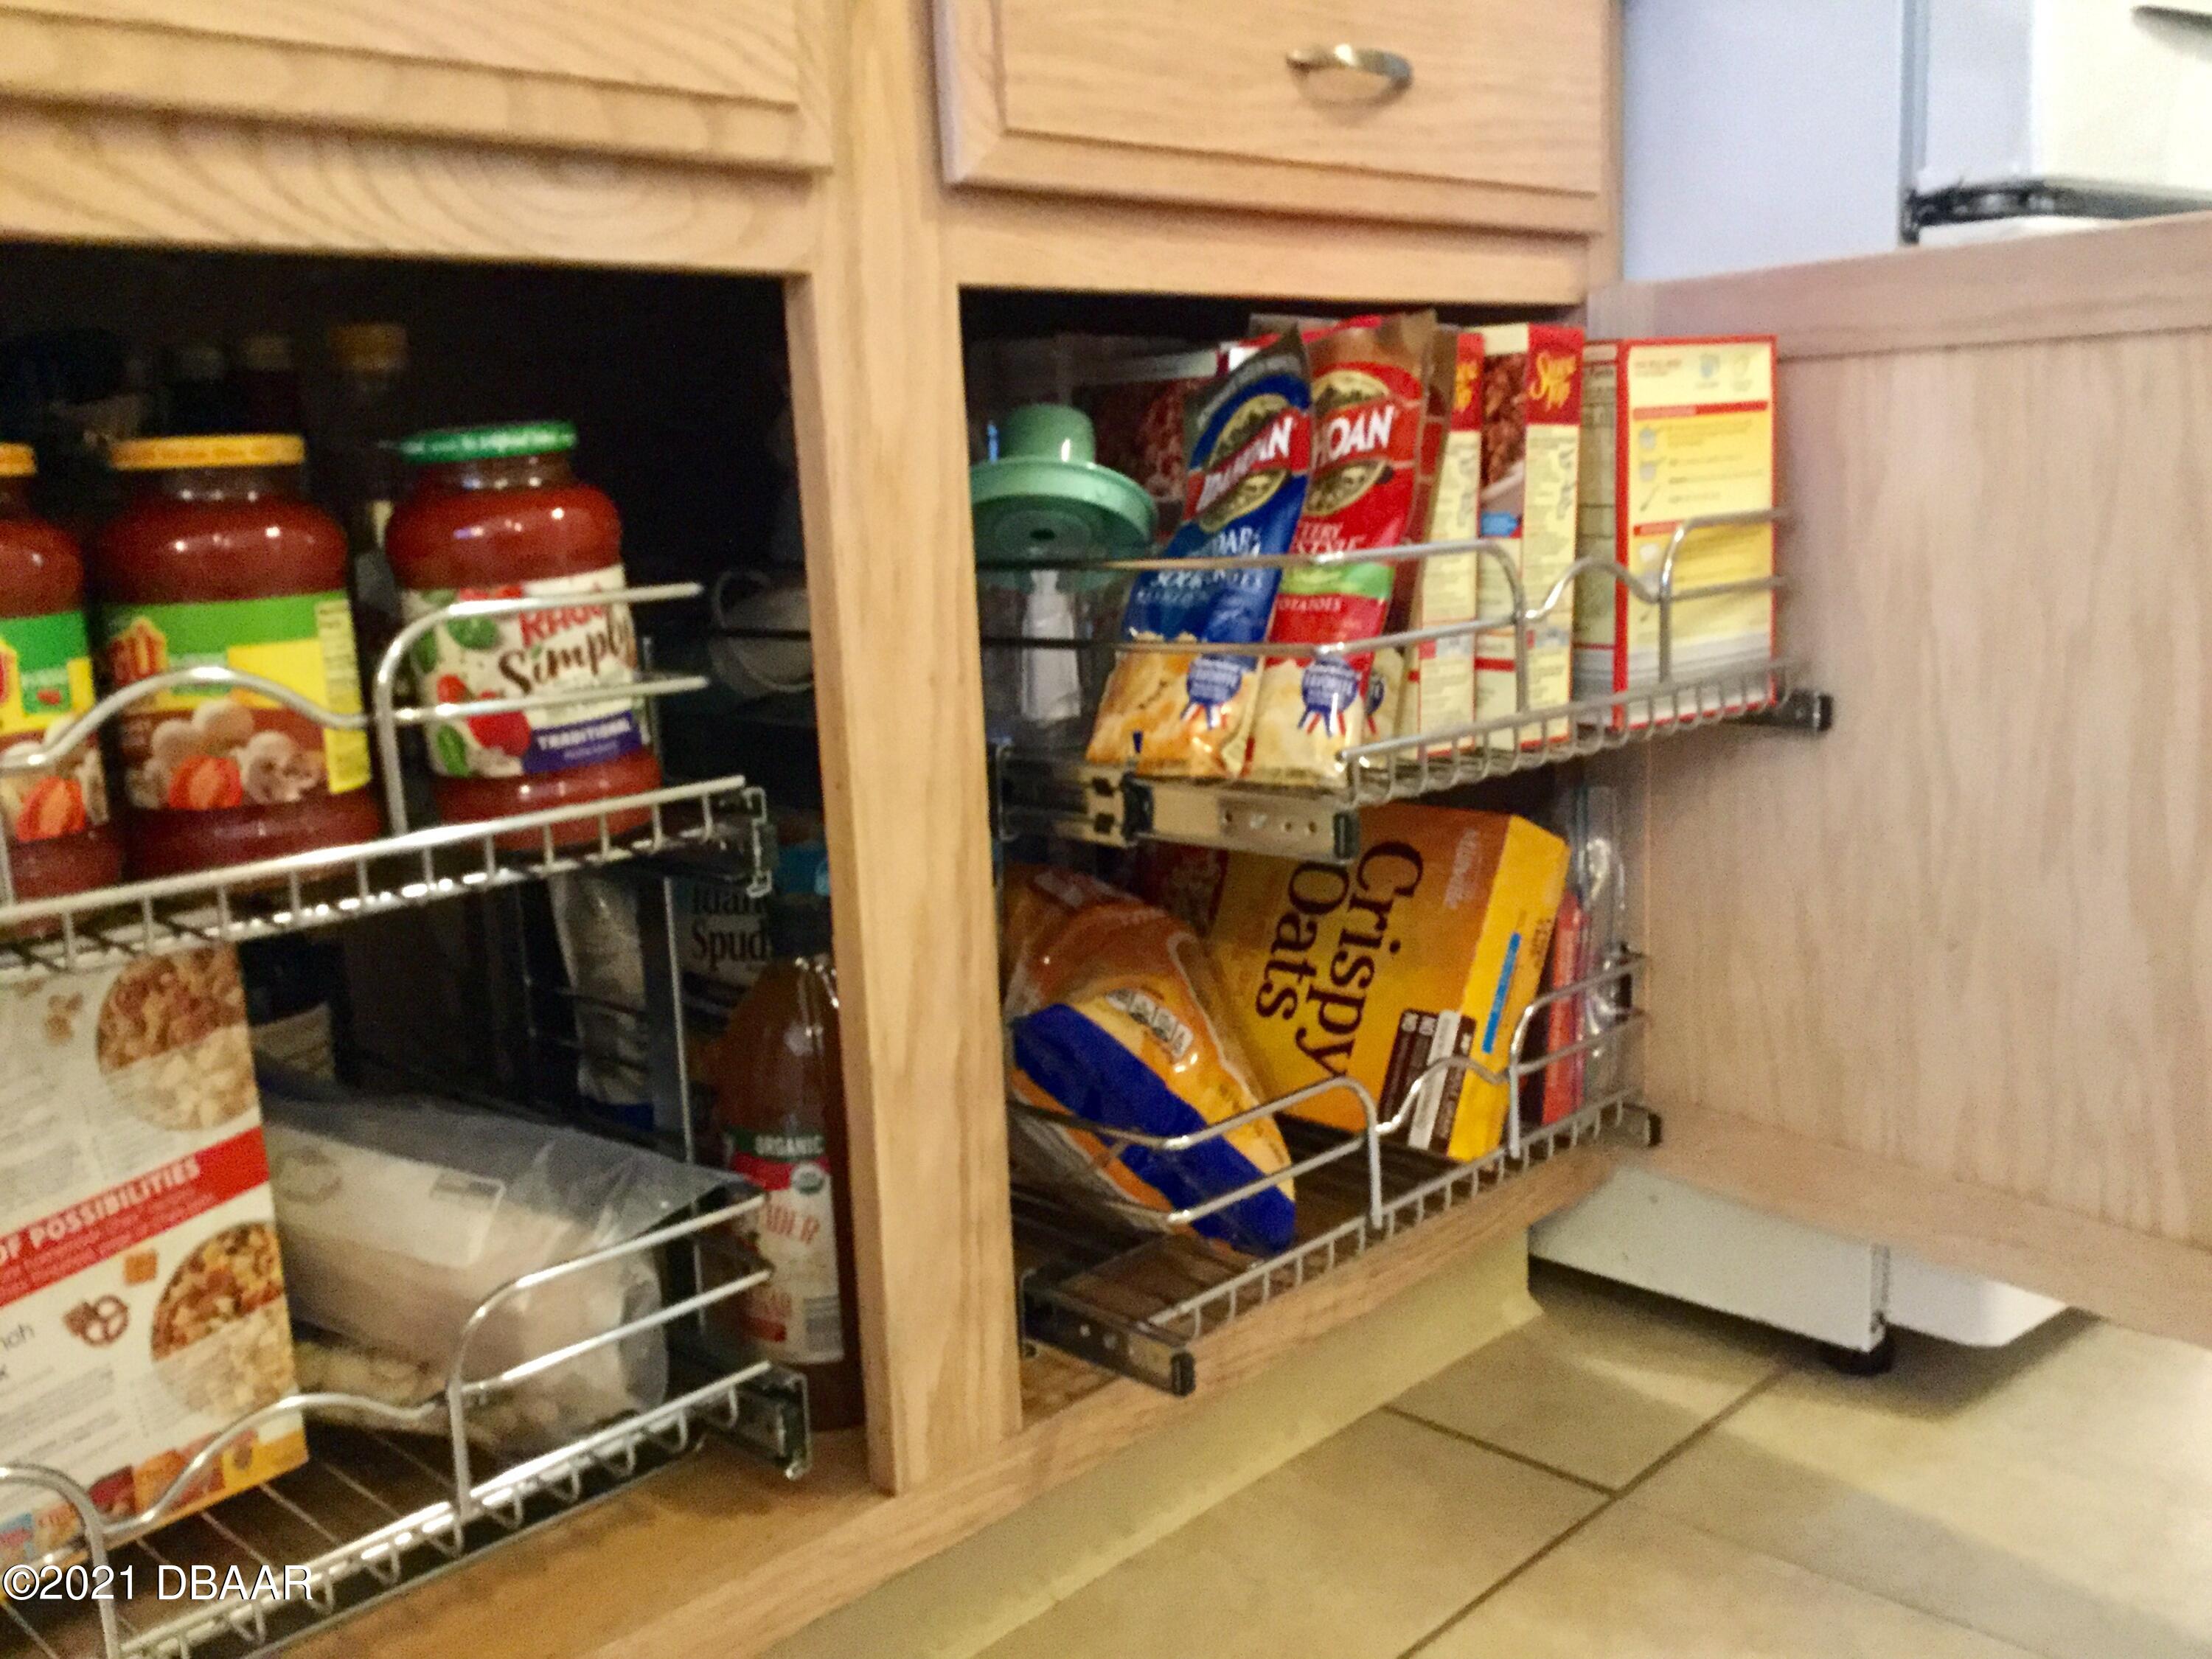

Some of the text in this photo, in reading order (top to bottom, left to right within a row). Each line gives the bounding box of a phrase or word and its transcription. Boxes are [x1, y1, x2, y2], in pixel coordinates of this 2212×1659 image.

[1255, 861, 1350, 1021] Oats
[1295, 841, 1424, 1077] Crispy
[28, 1153, 201, 1248] POSSIBILITIES
